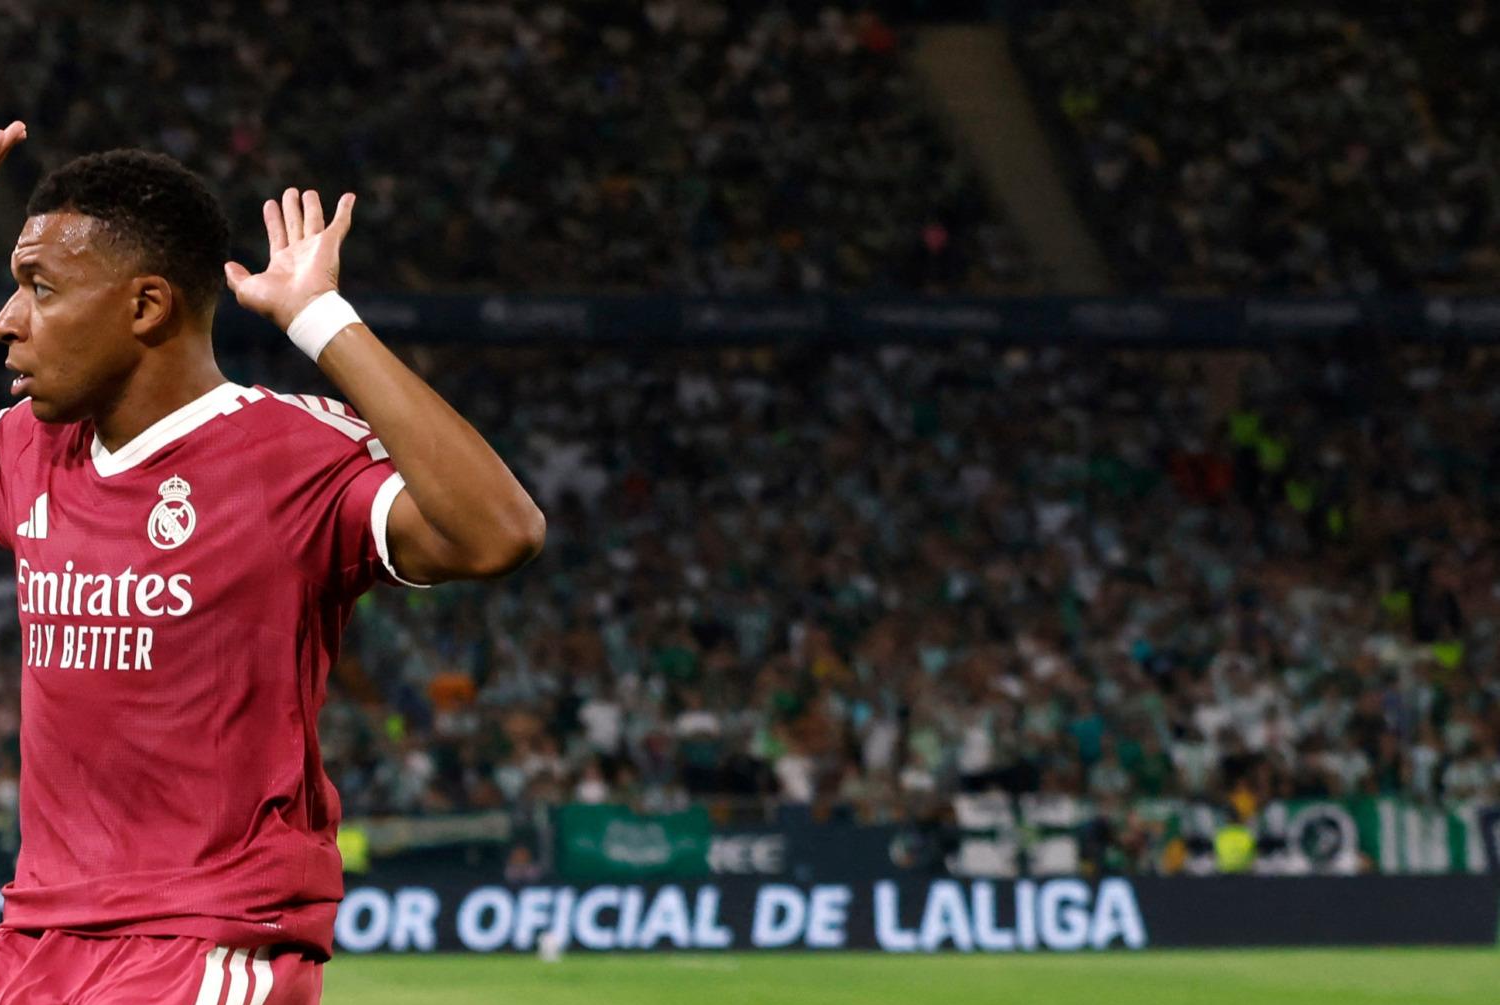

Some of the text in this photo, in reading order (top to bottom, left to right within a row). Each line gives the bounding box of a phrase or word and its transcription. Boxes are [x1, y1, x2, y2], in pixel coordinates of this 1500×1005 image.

[18, 558, 193, 617] Emirates
[27, 623, 154, 671] FLY BETTER
[457, 886, 732, 951] OFICIAL
[752, 884, 850, 949] DE
[873, 878, 1147, 951] LALIGA
